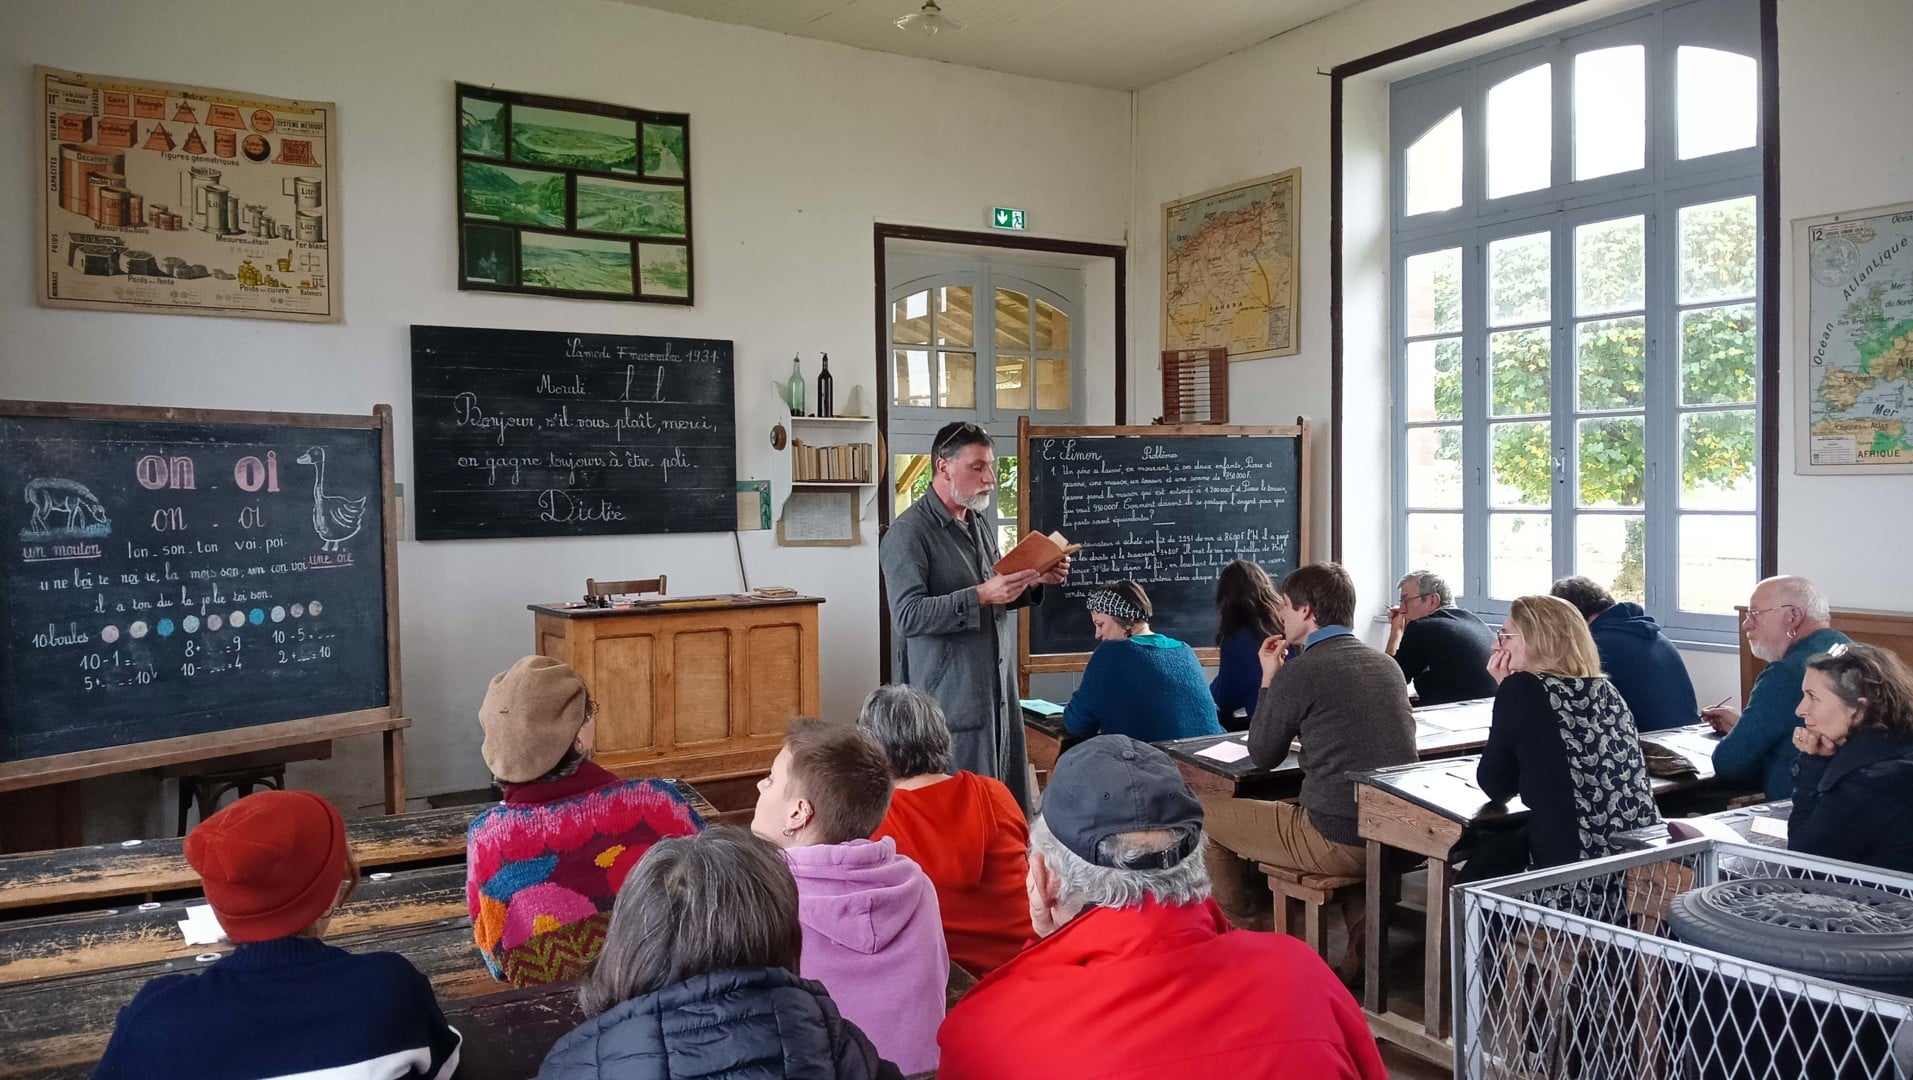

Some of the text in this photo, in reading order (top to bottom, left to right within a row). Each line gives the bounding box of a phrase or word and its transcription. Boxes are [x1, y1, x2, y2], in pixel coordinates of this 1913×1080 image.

[161, 151, 190, 162] Figures
[216, 233, 245, 244] Mesures
[1812, 230, 1823, 241] 12
[1842, 237, 1908, 301] Atlantique
[128, 275, 147, 285] Poids
[240, 283, 258, 293] Poids
[1872, 403, 1899, 418] Mer
[576, 417, 611, 429] vous
[614, 407, 661, 442] plaît,
[661, 415, 717, 433] merci,
[1059, 439, 1103, 461] Simon
[1857, 449, 1901, 459] AFRIQUE
[136, 450, 281, 492] on oi
[457, 456, 480, 468] on
[485, 457, 543, 487] gagne
[548, 452, 606, 486] toujours
[608, 450, 624, 468] à
[624, 451, 655, 469] être
[537, 488, 627, 523] Dictée
[150, 499, 266, 533] on oi
[21, 541, 102, 560] un mouton
[162, 544, 186, 556] son
[164, 561, 180, 581] la
